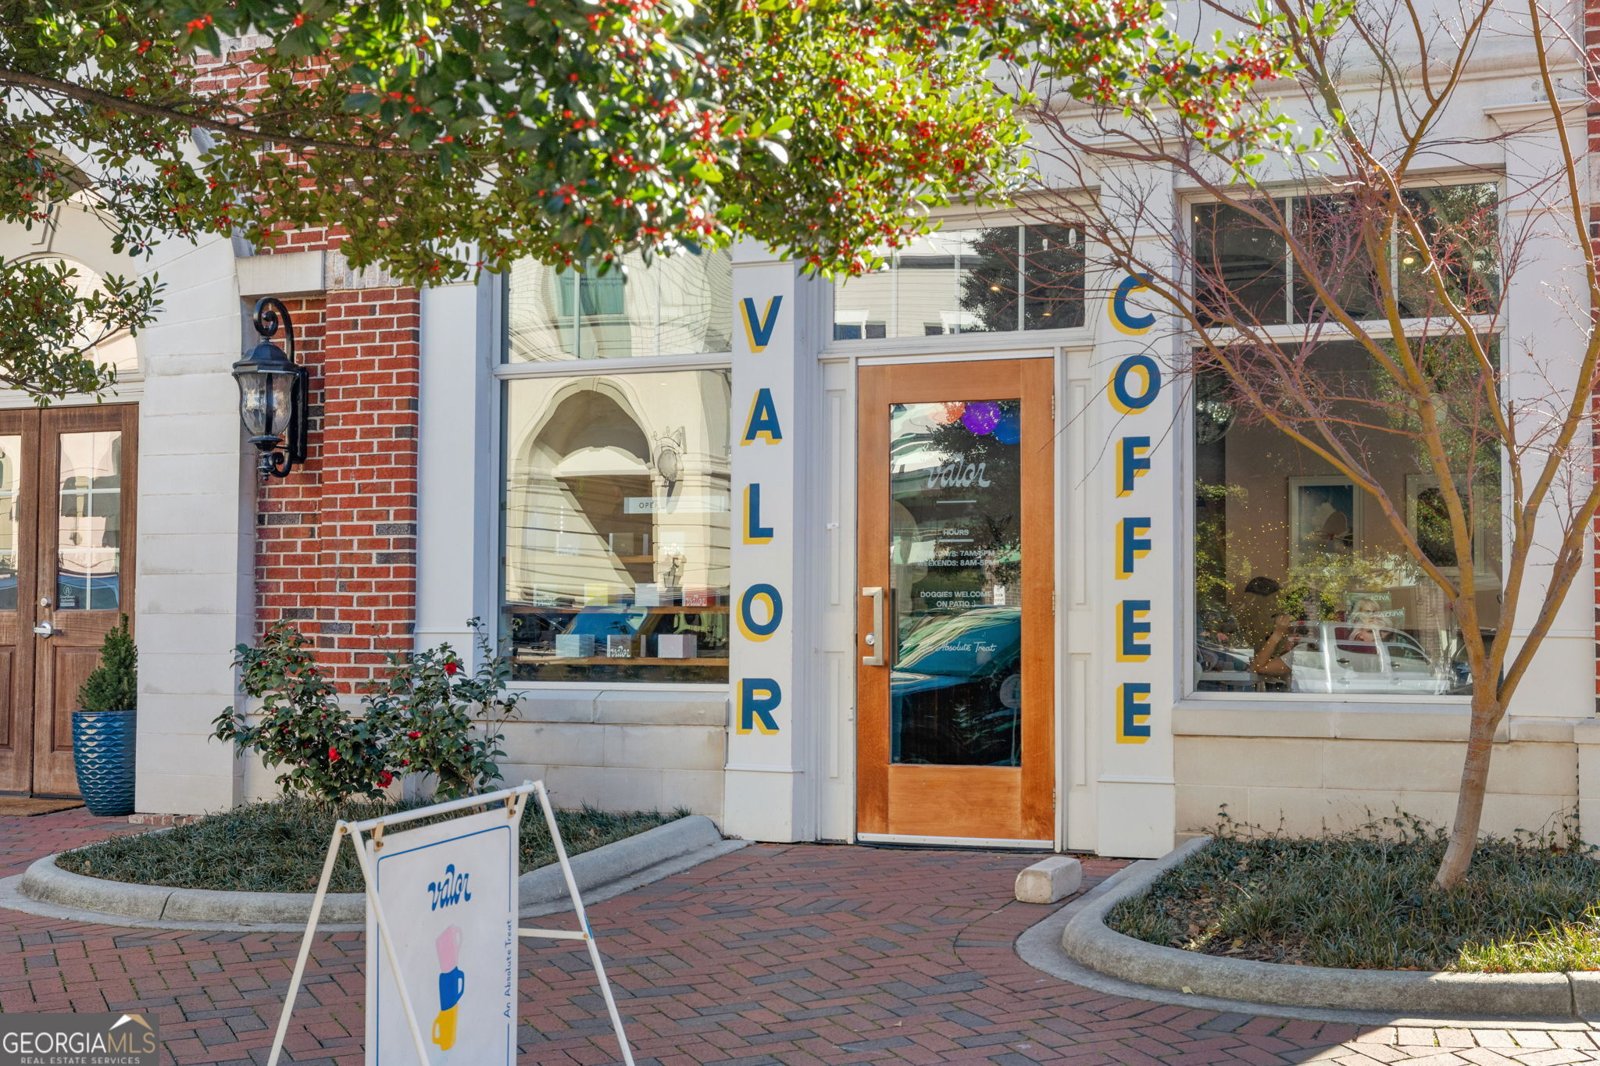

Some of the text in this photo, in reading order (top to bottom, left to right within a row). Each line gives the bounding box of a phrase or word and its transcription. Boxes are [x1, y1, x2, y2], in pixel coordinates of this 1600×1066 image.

[638, 501, 659, 510] OPE
[736, 295, 783, 735] VALOR
[1108, 273, 1161, 744] COFFEE
[936, 600, 948, 608] ON
[949, 600, 970, 608] PATIO
[973, 641, 998, 653] Treat
[427, 863, 472, 912] valor
[503, 919, 512, 1018] An Absolute Treat
